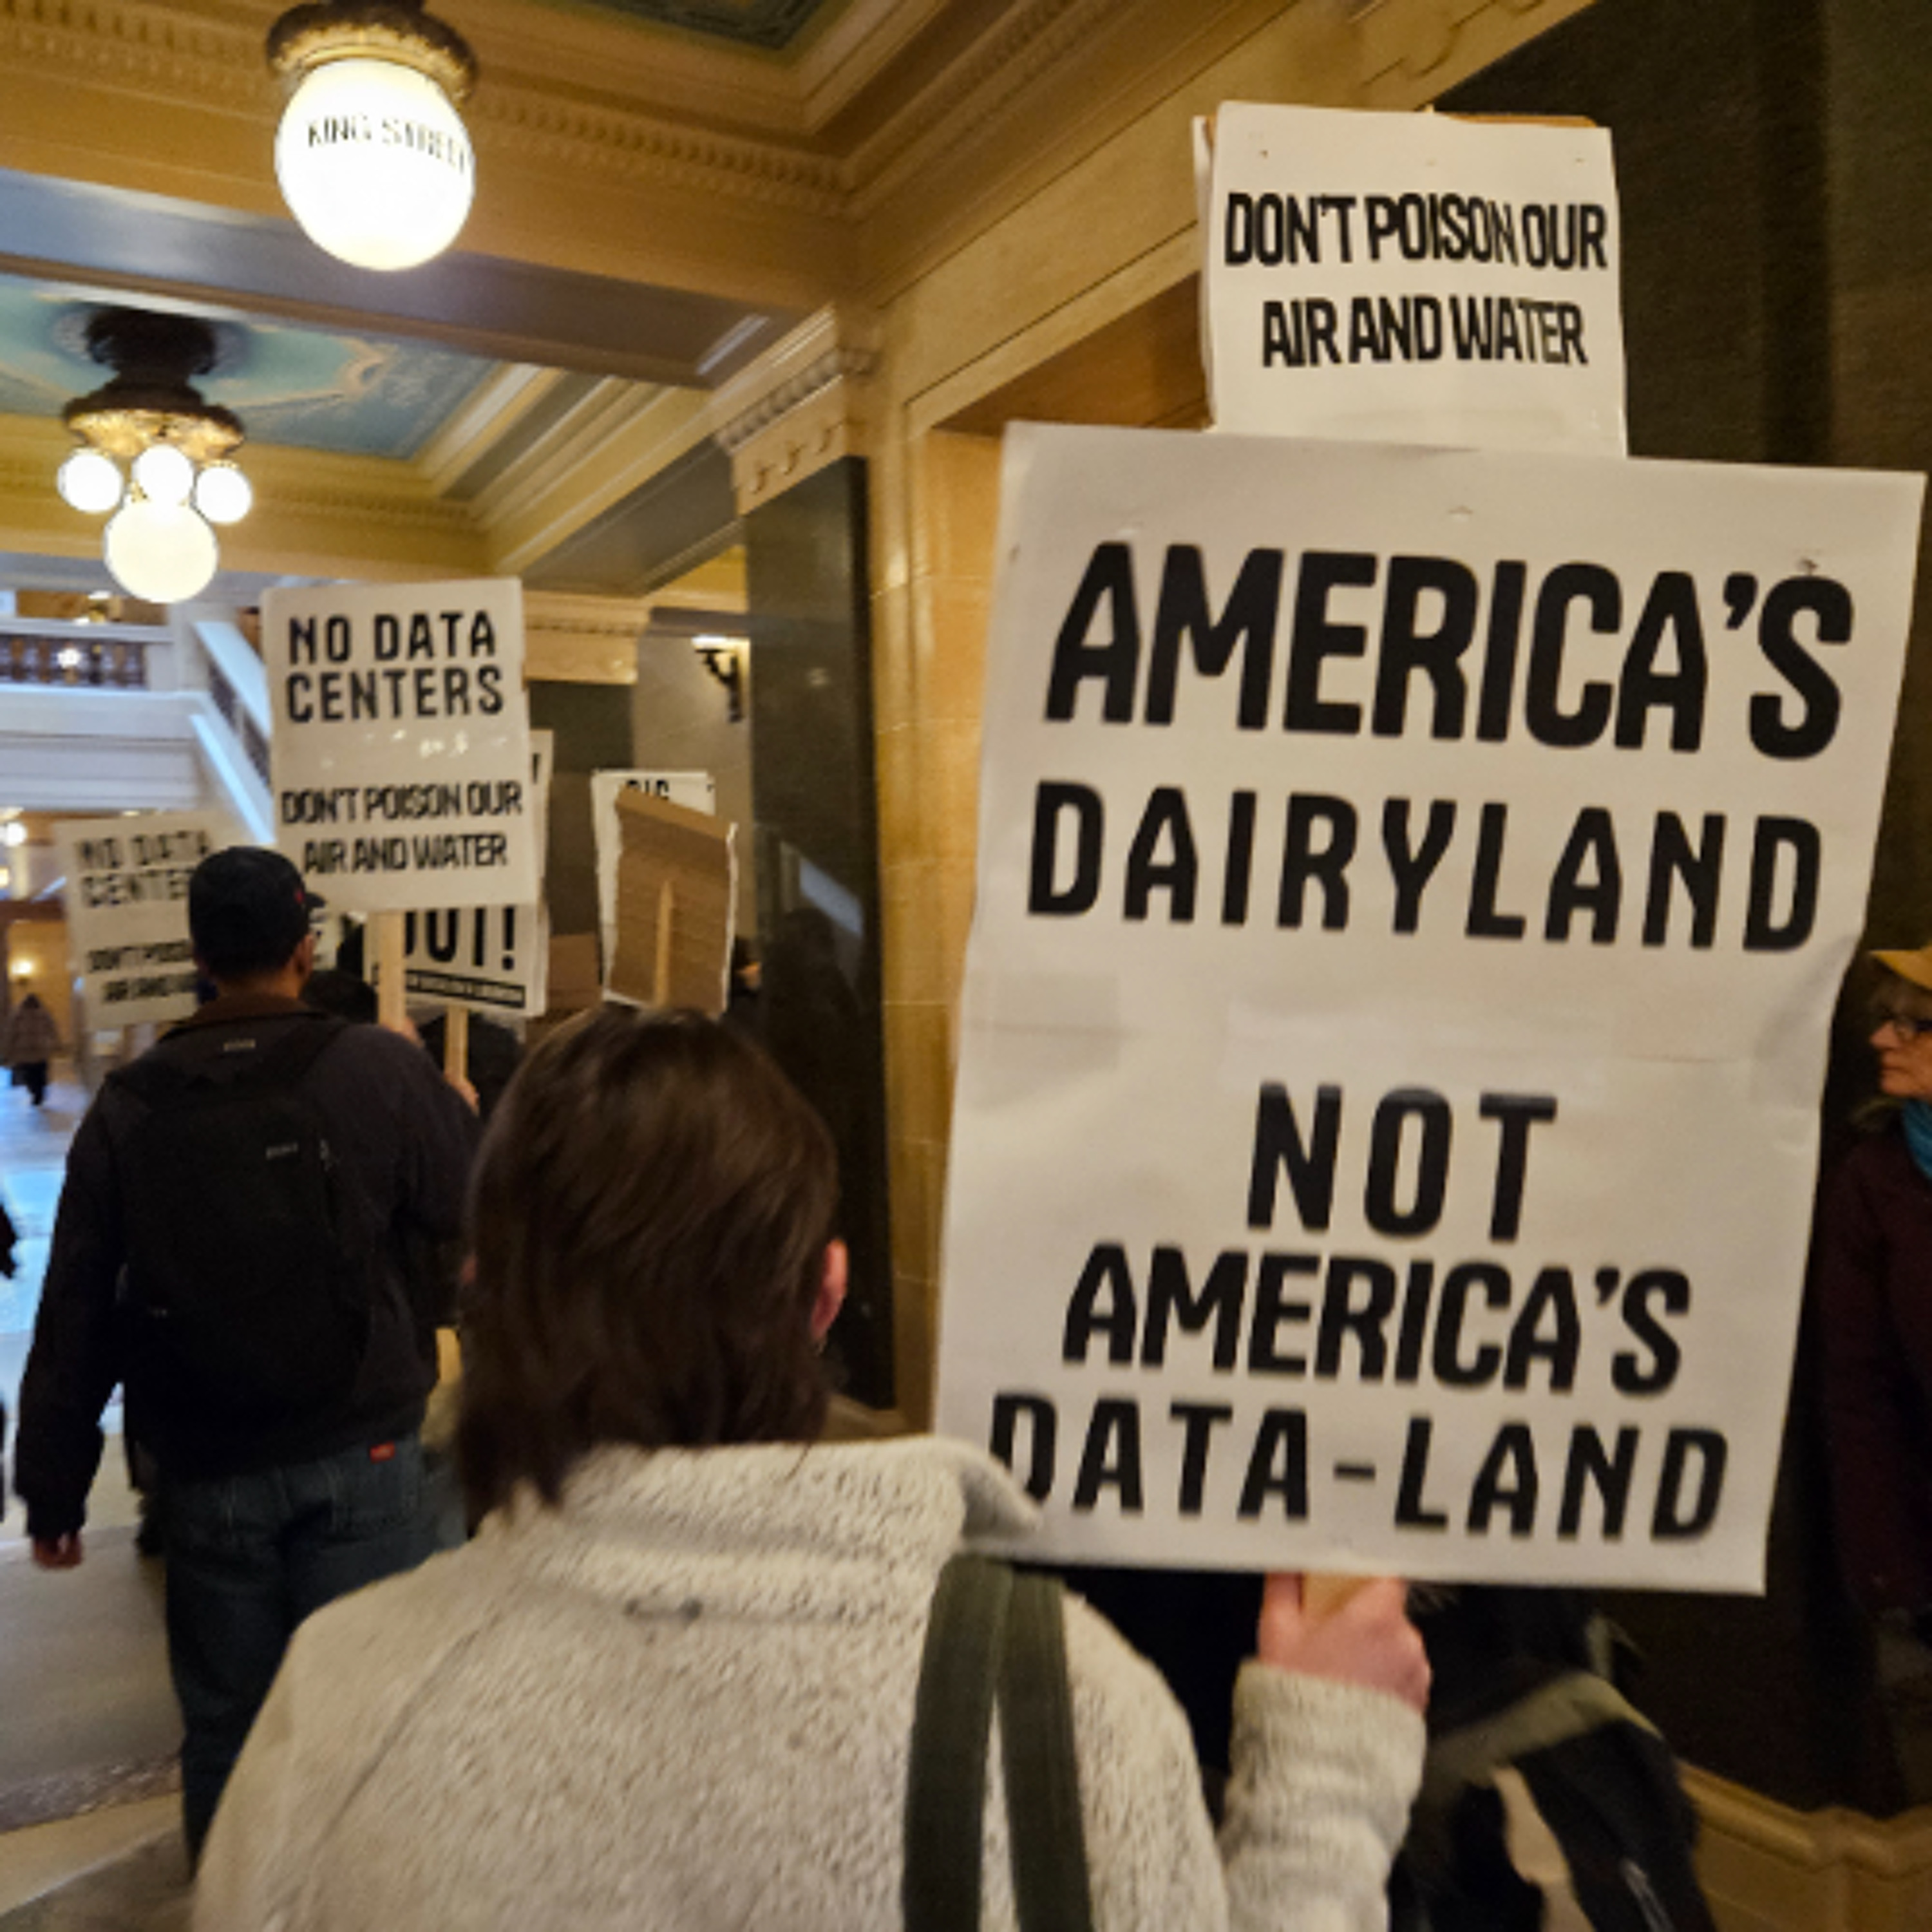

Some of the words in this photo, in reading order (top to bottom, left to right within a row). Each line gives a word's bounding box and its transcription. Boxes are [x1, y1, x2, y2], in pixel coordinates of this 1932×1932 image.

[307, 113, 372, 147] KING
[1224, 191, 1357, 267] DON'T
[1363, 192, 1519, 265] POISON
[1520, 203, 1608, 270] OUR
[1262, 298, 1342, 368] AIR
[1349, 295, 1444, 364] AND
[1448, 295, 1589, 366] WATER
[289, 614, 352, 665] NO
[374, 610, 496, 661] DATA
[1044, 540, 1854, 761] AMERICA'S
[285, 664, 504, 724] CENTERS
[281, 787, 359, 824] DON'T
[363, 782, 462, 821] POISON
[466, 779, 522, 817] OUR
[303, 840, 348, 875] AIR
[351, 837, 408, 873] AND
[412, 832, 507, 869] WATER
[1027, 779, 1822, 953] DAIRYLAND
[1246, 1083, 1558, 1244] NOT
[1061, 1242, 1691, 1398] AMERICA'S
[989, 1392, 1728, 1544] DATA-LAND
